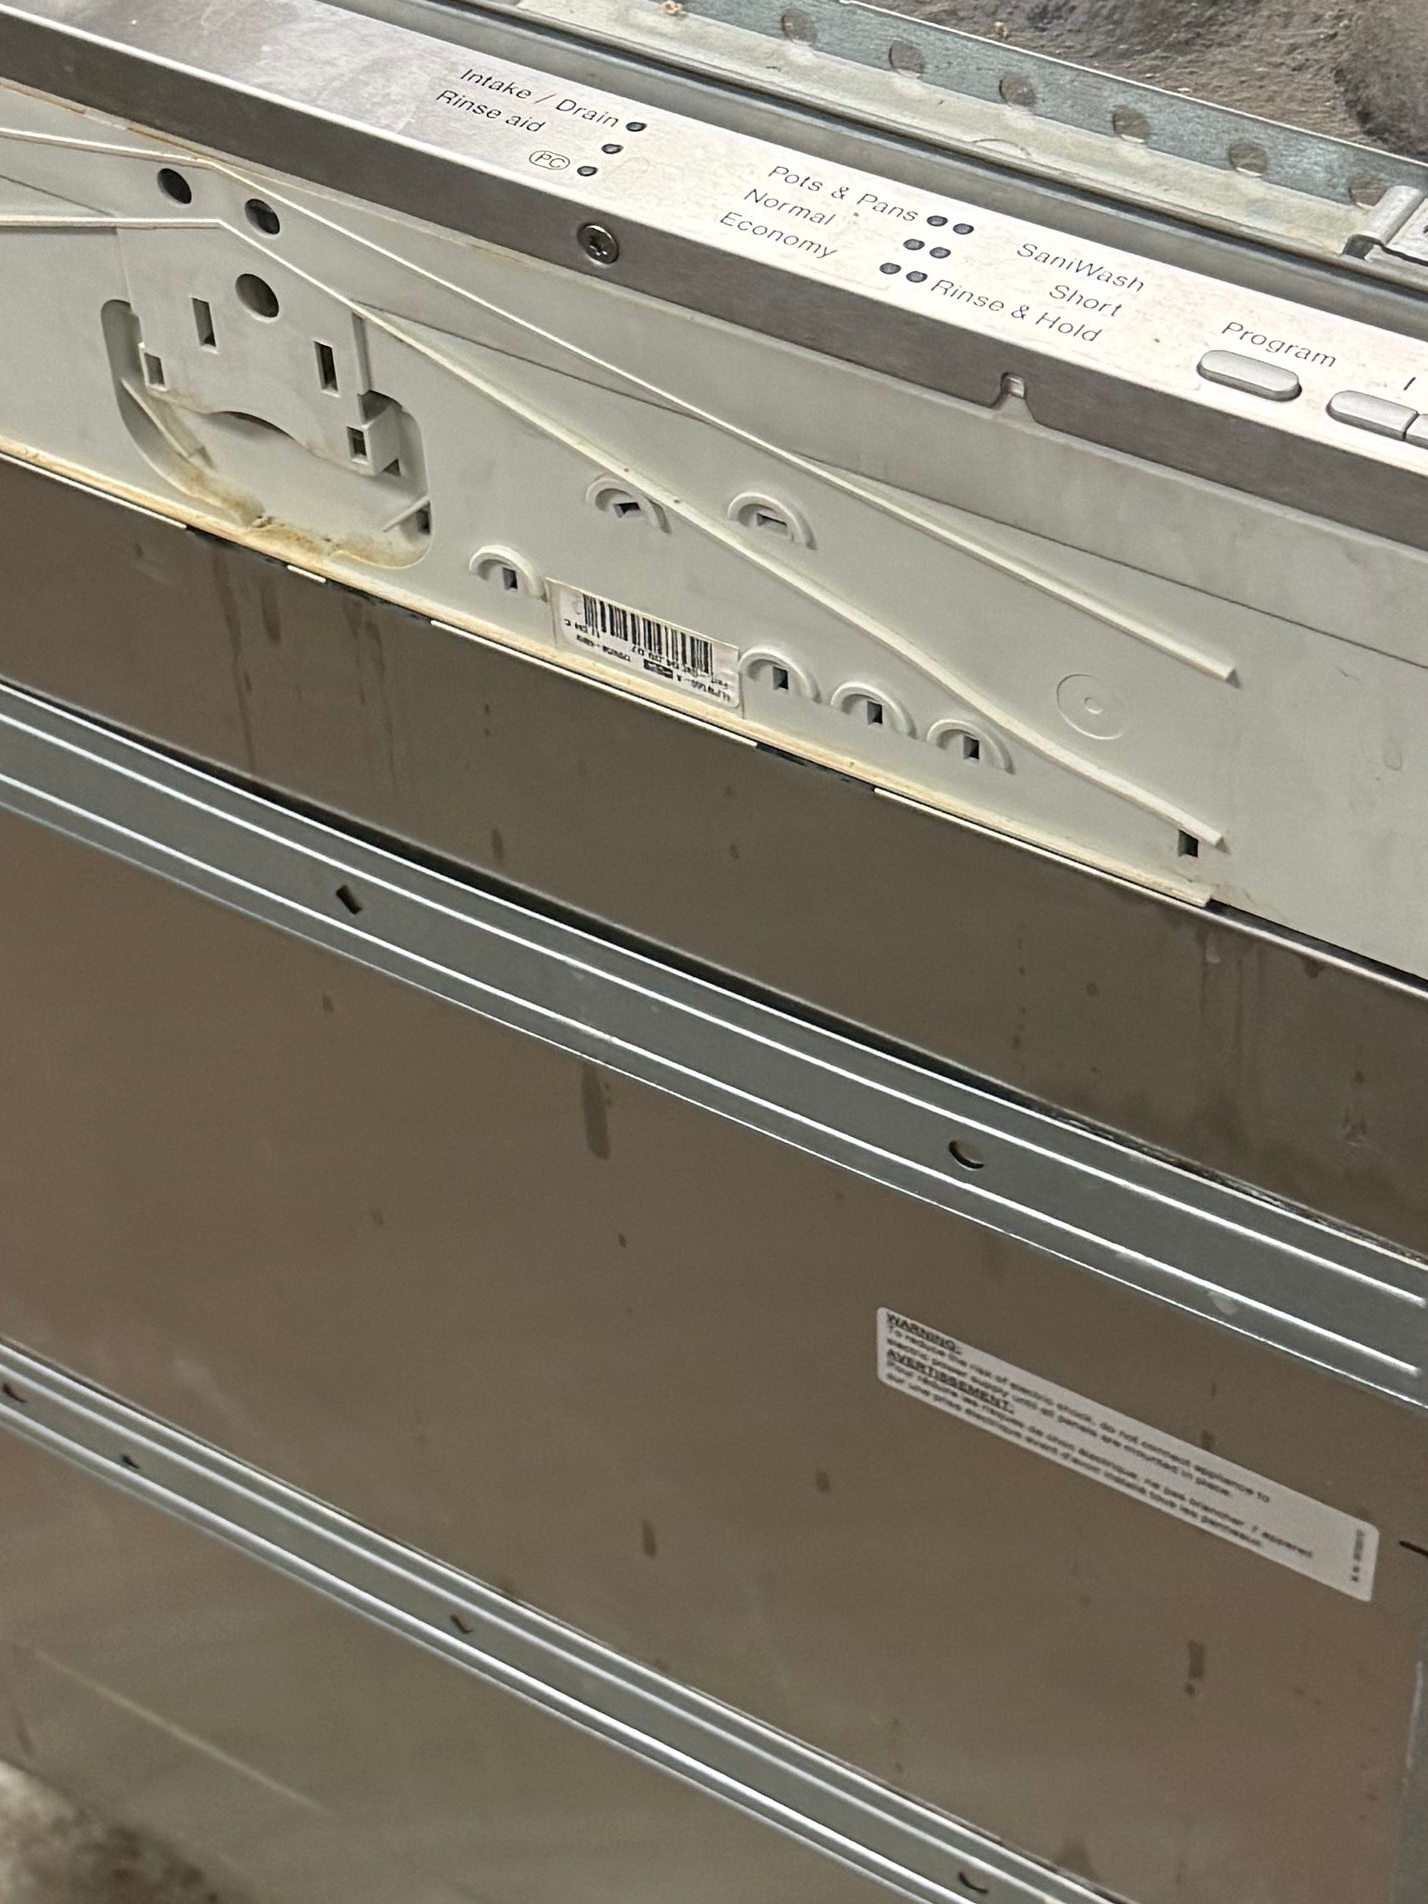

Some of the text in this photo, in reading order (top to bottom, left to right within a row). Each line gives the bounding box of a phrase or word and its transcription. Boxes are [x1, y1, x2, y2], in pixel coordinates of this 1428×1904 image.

[436, 90, 547, 133] Rinse aid
[461, 68, 619, 128] Intake / Drain
[533, 152, 568, 169] PC
[744, 188, 836, 226] Normal
[768, 165, 918, 223] Pots & Pans
[719, 211, 838, 261] Economy
[1017, 243, 1145, 294] SaniWash
[931, 279, 1102, 344] Rinse & Hold
[1050, 284, 1124, 318] Short
[1221, 321, 1337, 369] Program
